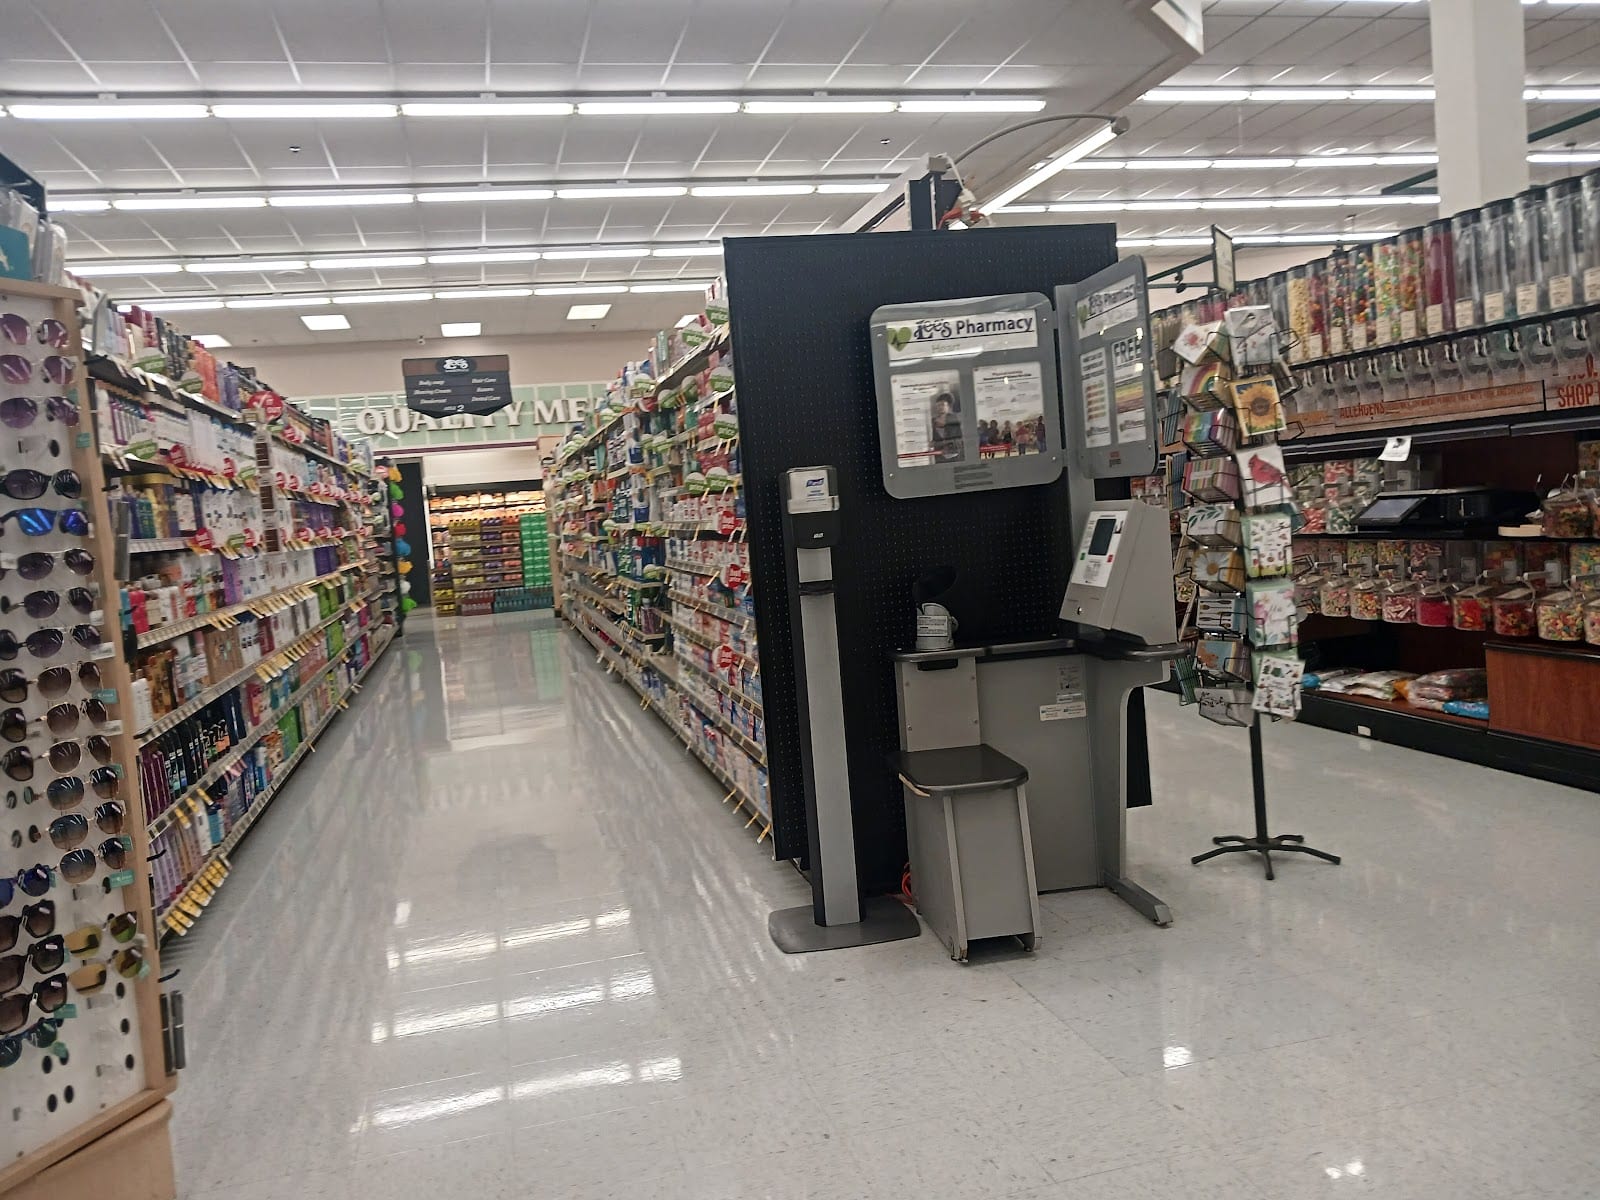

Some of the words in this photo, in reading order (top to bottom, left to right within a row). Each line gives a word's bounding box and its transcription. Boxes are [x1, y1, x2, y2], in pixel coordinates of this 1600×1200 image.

[956, 317, 1033, 335] Pharmacy
[1113, 338, 1142, 366] FREE
[1557, 382, 1594, 408] SHOP
[456, 404, 465, 412] 2
[533, 397, 605, 426] ME
[1339, 401, 1386, 419] ALLERGENS
